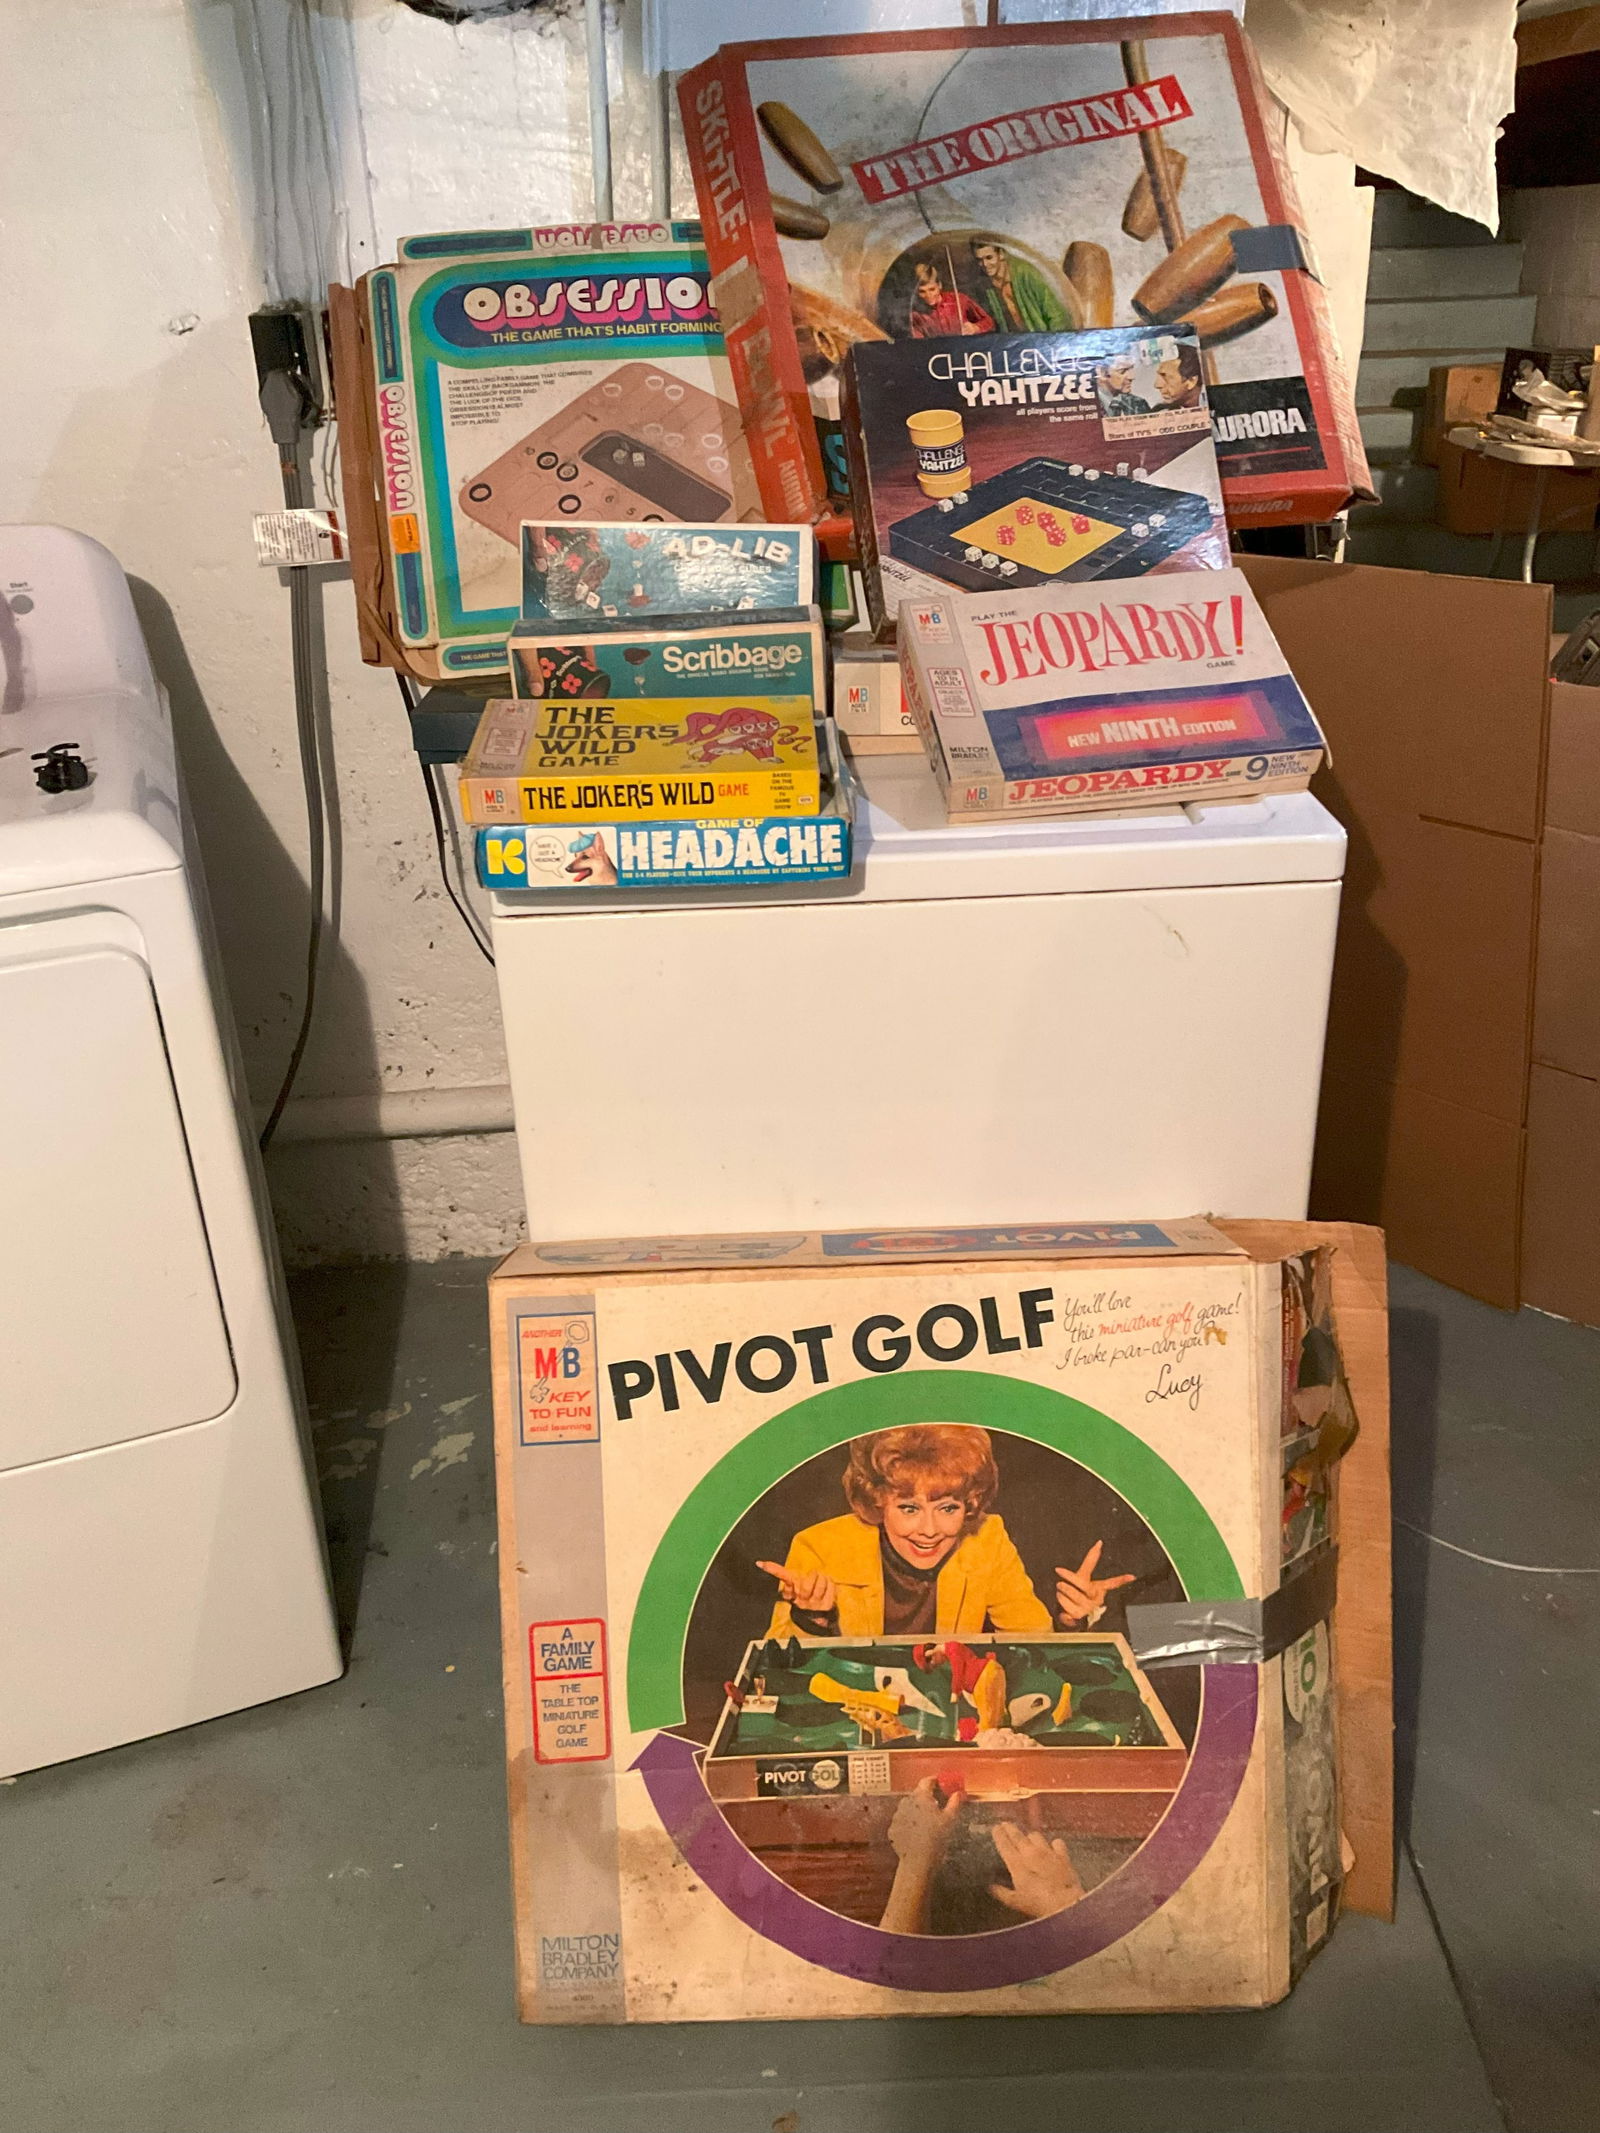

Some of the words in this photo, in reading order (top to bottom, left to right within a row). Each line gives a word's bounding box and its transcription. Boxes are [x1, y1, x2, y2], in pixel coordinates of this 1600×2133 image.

[864, 138, 971, 196] THE
[967, 84, 1182, 164] ORIGINAL
[491, 332, 519, 343] THE
[521, 329, 562, 342] GAME
[566, 326, 614, 338] THAT'S
[617, 324, 657, 335] HABIT
[661, 321, 722, 334] FORMING
[958, 373, 1095, 406] YAHTZEE
[383, 385, 415, 509] OBSESSION
[662, 535, 793, 564] AD-LIB
[919, 613, 941, 624] MB
[971, 614, 995, 623] PLAY
[998, 610, 1018, 618] THE
[975, 595, 1244, 686] JEOPARDY!
[663, 642, 802, 672] Scribbage
[1206, 660, 1237, 669] GAME
[849, 687, 869, 703] MB
[545, 707, 615, 724] THE
[1067, 732, 1099, 748] NEW
[1101, 717, 1181, 744] NINTH
[1182, 719, 1237, 736] EDITION
[540, 740, 636, 755] WILD
[538, 755, 620, 768] GAME
[1271, 761, 1301, 770] NINTH
[1272, 754, 1296, 762] NEW
[1245, 756, 1269, 781] 9
[1267, 766, 1309, 777] EDITION
[1009, 760, 1232, 801] JEOPARDY
[484, 789, 504, 805] MB
[524, 787, 566, 810] THE
[659, 781, 714, 806] WILD
[718, 783, 749, 797] GAME
[966, 786, 988, 802] MB
[696, 819, 739, 830] GAME
[743, 818, 765, 829] OF
[620, 825, 842, 871] HEADACHE
[1107, 1290, 1132, 1311] love
[1070, 1322, 1095, 1344] this
[1099, 1314, 1162, 1337] miniature
[1163, 1302, 1194, 1340] golf
[1193, 1292, 1242, 1336] game!
[522, 1329, 563, 1339] ANOTHER
[608, 1325, 833, 1421] PIVOT
[851, 1287, 1055, 1373] GOLF
[1073, 1344, 1107, 1366] broke
[534, 1347, 581, 1379] MB
[1145, 1364, 1204, 1411] Lucy
[549, 1390, 591, 1403] KEY
[529, 1408, 551, 1420] TO
[556, 1406, 592, 1418] FUN
[530, 1424, 549, 1433] and
[551, 1423, 592, 1431] learning
[561, 1627, 574, 1641] A
[541, 1640, 595, 1658] FAMILY
[543, 1656, 593, 1672] GAME
[559, 1683, 581, 1694] THE
[541, 1697, 575, 1709] TABLE
[576, 1696, 599, 1706] TOP
[543, 1709, 600, 1722] MINIATURE
[557, 1723, 588, 1735] GOLF
[555, 1737, 589, 1749] GAME
[764, 1770, 806, 1784] PIVOT
[541, 1933, 619, 1952] MILTON
[542, 1948, 618, 1967] BRADLEY
[543, 1963, 619, 1980] COMPANY
